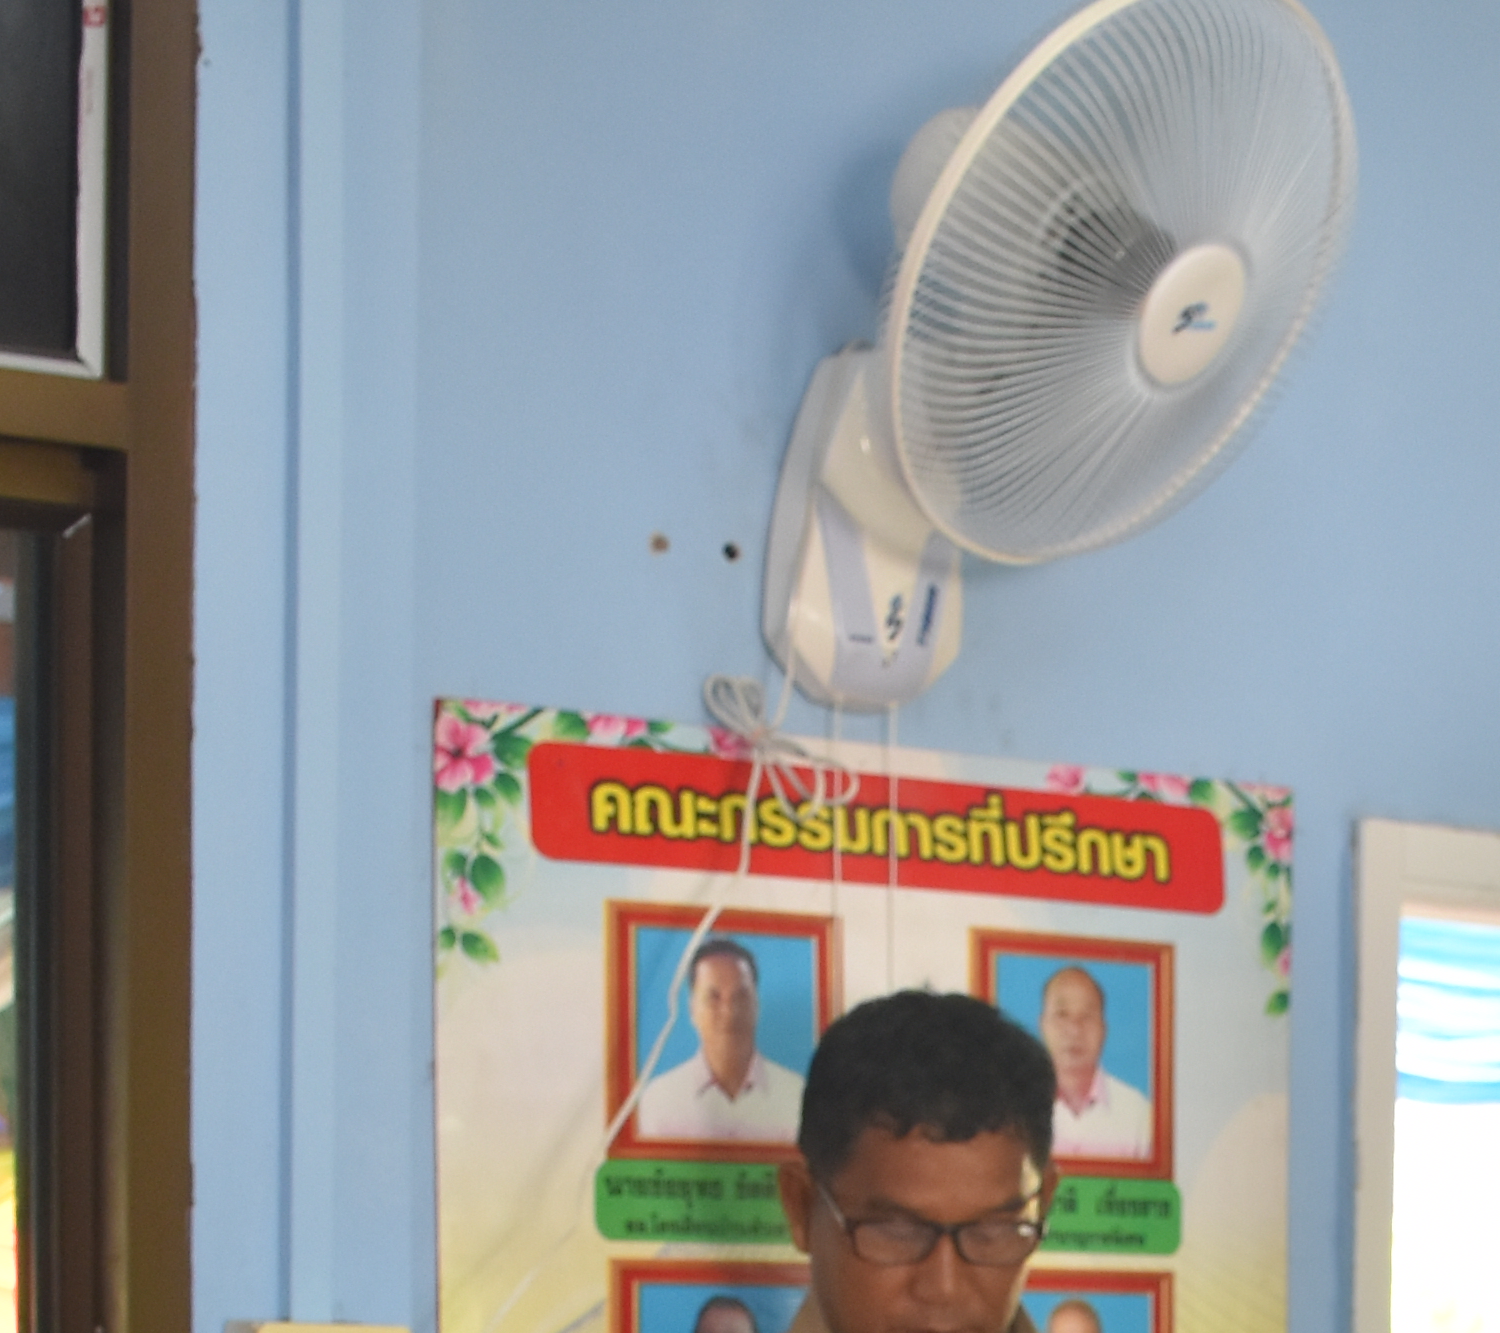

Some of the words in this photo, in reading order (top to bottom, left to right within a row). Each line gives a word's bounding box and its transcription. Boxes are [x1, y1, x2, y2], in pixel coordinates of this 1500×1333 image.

[590, 780, 1171, 883] คณะกรรมการที่ปรึกษา
